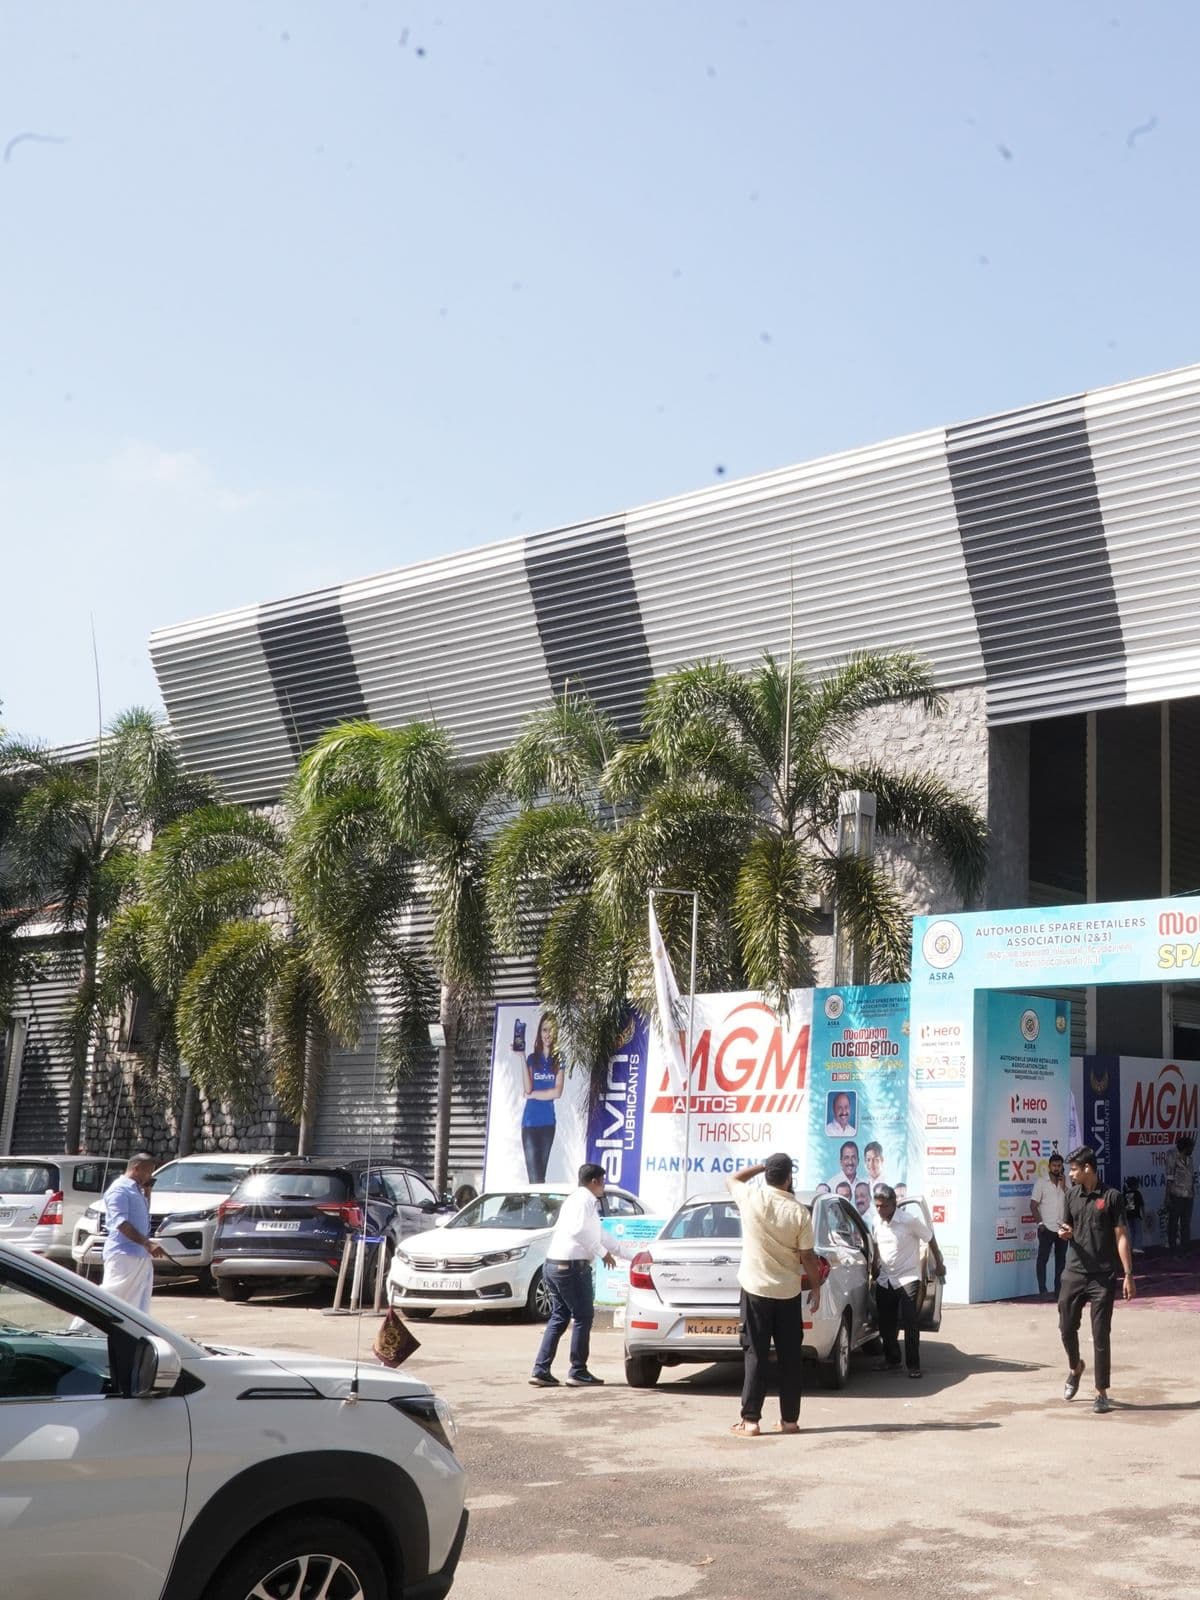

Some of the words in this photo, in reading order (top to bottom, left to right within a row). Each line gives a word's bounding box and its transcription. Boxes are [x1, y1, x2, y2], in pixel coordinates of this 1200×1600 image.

[975, 924, 1045, 937] AUTOMOBILE
[1048, 921, 1083, 933] SPARE
[1086, 917, 1146, 930] RETAILERS
[1006, 934, 1081, 947] ASSOCIATION
[1083, 932, 1112, 944] (2&3)
[928, 972, 954, 981] ASRA
[933, 1026, 961, 1037] Hero
[831, 1041, 899, 1059] സമ്മേളനം
[533, 1072, 555, 1080] Galvin
[915, 1068, 959, 1080] EXPO
[624, 1054, 640, 1150] LUBRICANTS
[672, 1096, 738, 1113] AUTOS
[1022, 1098, 1048, 1111] Hero
[1130, 1081, 1198, 1130] MGM
[595, 1054, 629, 1186] alvin
[698, 1122, 773, 1143] THRISSUR
[1137, 1133, 1170, 1145] AUTOS
[998, 1140, 1051, 1157] SPARE
[646, 1156, 705, 1174] HANOK
[1002, 1251, 1014, 1261] NOV
